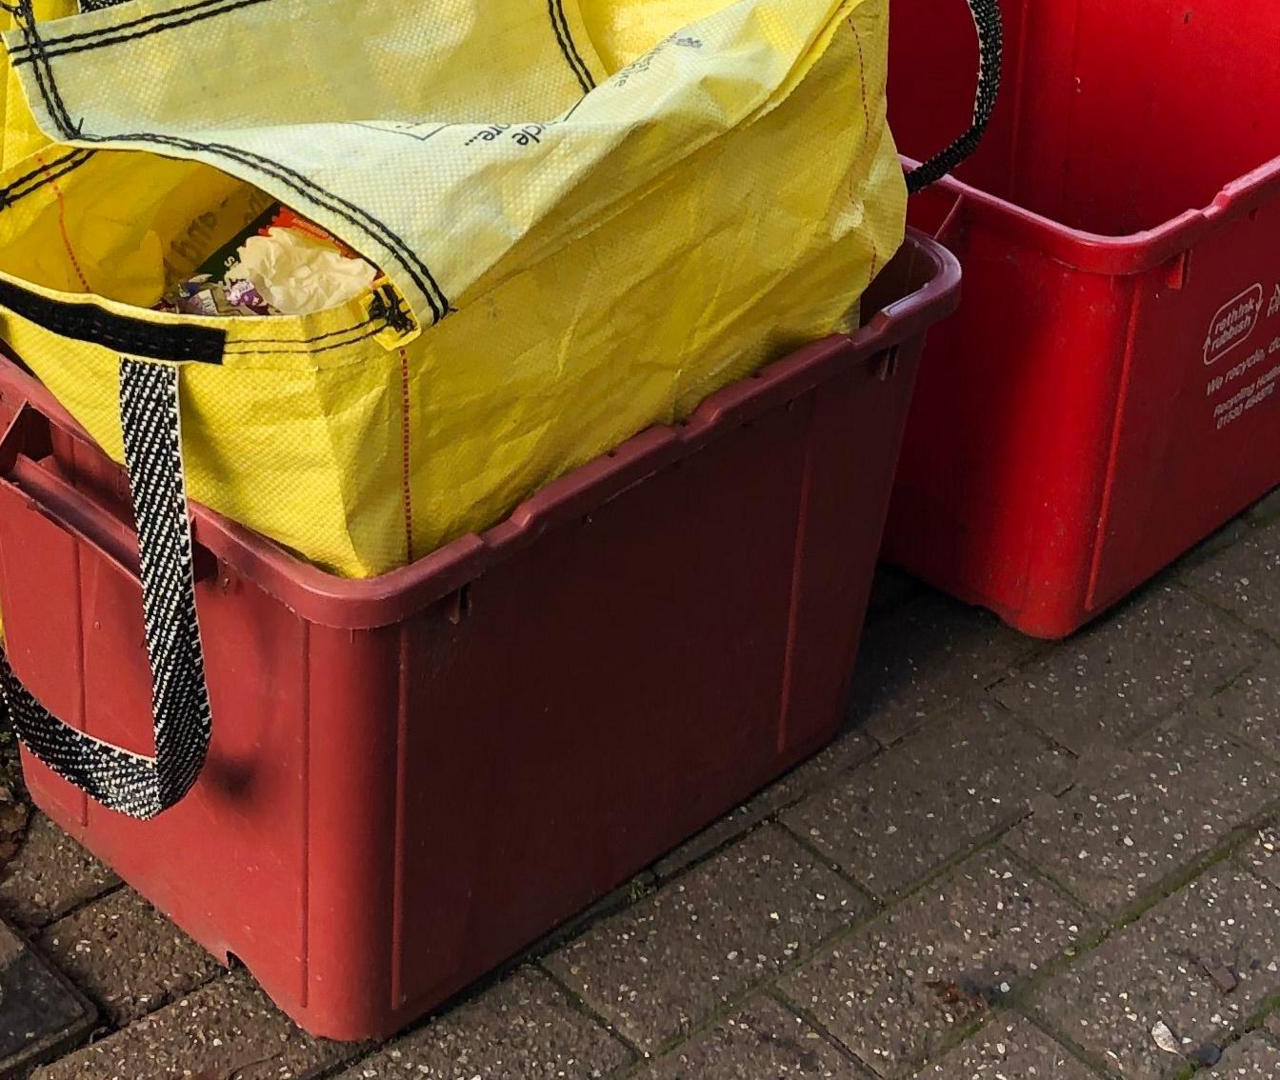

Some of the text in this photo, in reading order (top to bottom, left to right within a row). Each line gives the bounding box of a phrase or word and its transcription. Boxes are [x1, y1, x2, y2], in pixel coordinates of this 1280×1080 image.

[1211, 314, 1252, 352] rubbish
[1214, 297, 1257, 334] rethink
[1206, 375, 1223, 396] We
